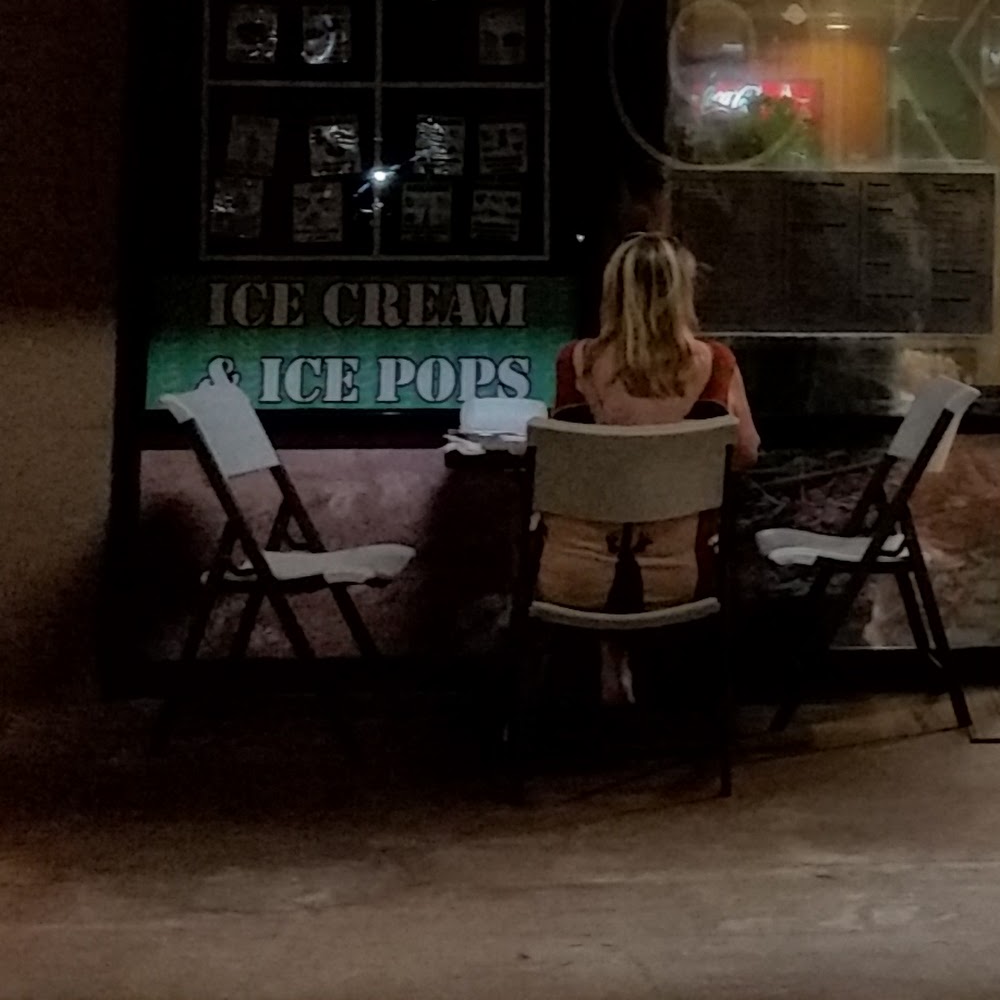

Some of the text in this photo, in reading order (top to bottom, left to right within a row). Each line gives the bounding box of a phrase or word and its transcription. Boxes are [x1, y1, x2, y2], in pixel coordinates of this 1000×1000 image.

[207, 281, 529, 328] ICE CREAM
[259, 356, 360, 403] ICE
[376, 355, 532, 402] POPS
